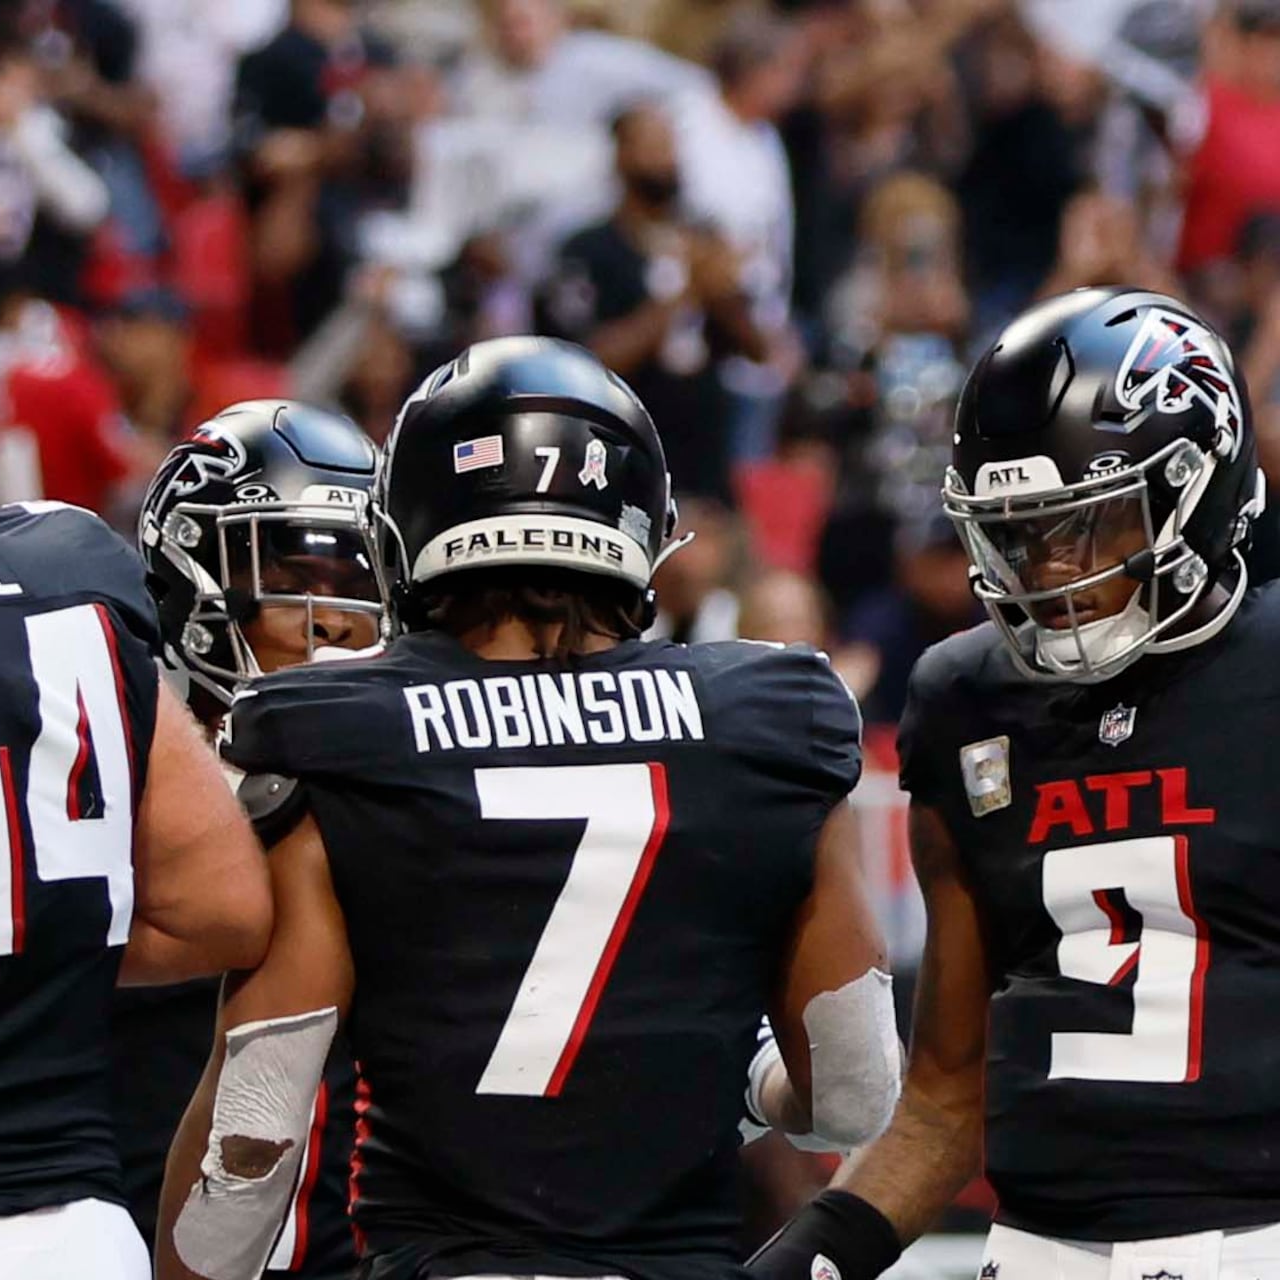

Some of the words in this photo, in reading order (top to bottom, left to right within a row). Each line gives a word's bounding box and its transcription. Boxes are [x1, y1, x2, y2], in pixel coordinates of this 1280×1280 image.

[328, 489, 364, 503] AT
[535, 447, 560, 493] 7
[988, 467, 1030, 486] ATL
[445, 529, 624, 562] FALCONS
[403, 669, 704, 753] ROBINSON
[1027, 767, 1217, 844] ATL
[474, 762, 671, 1097] 7
[1041, 834, 1210, 1083] 9
